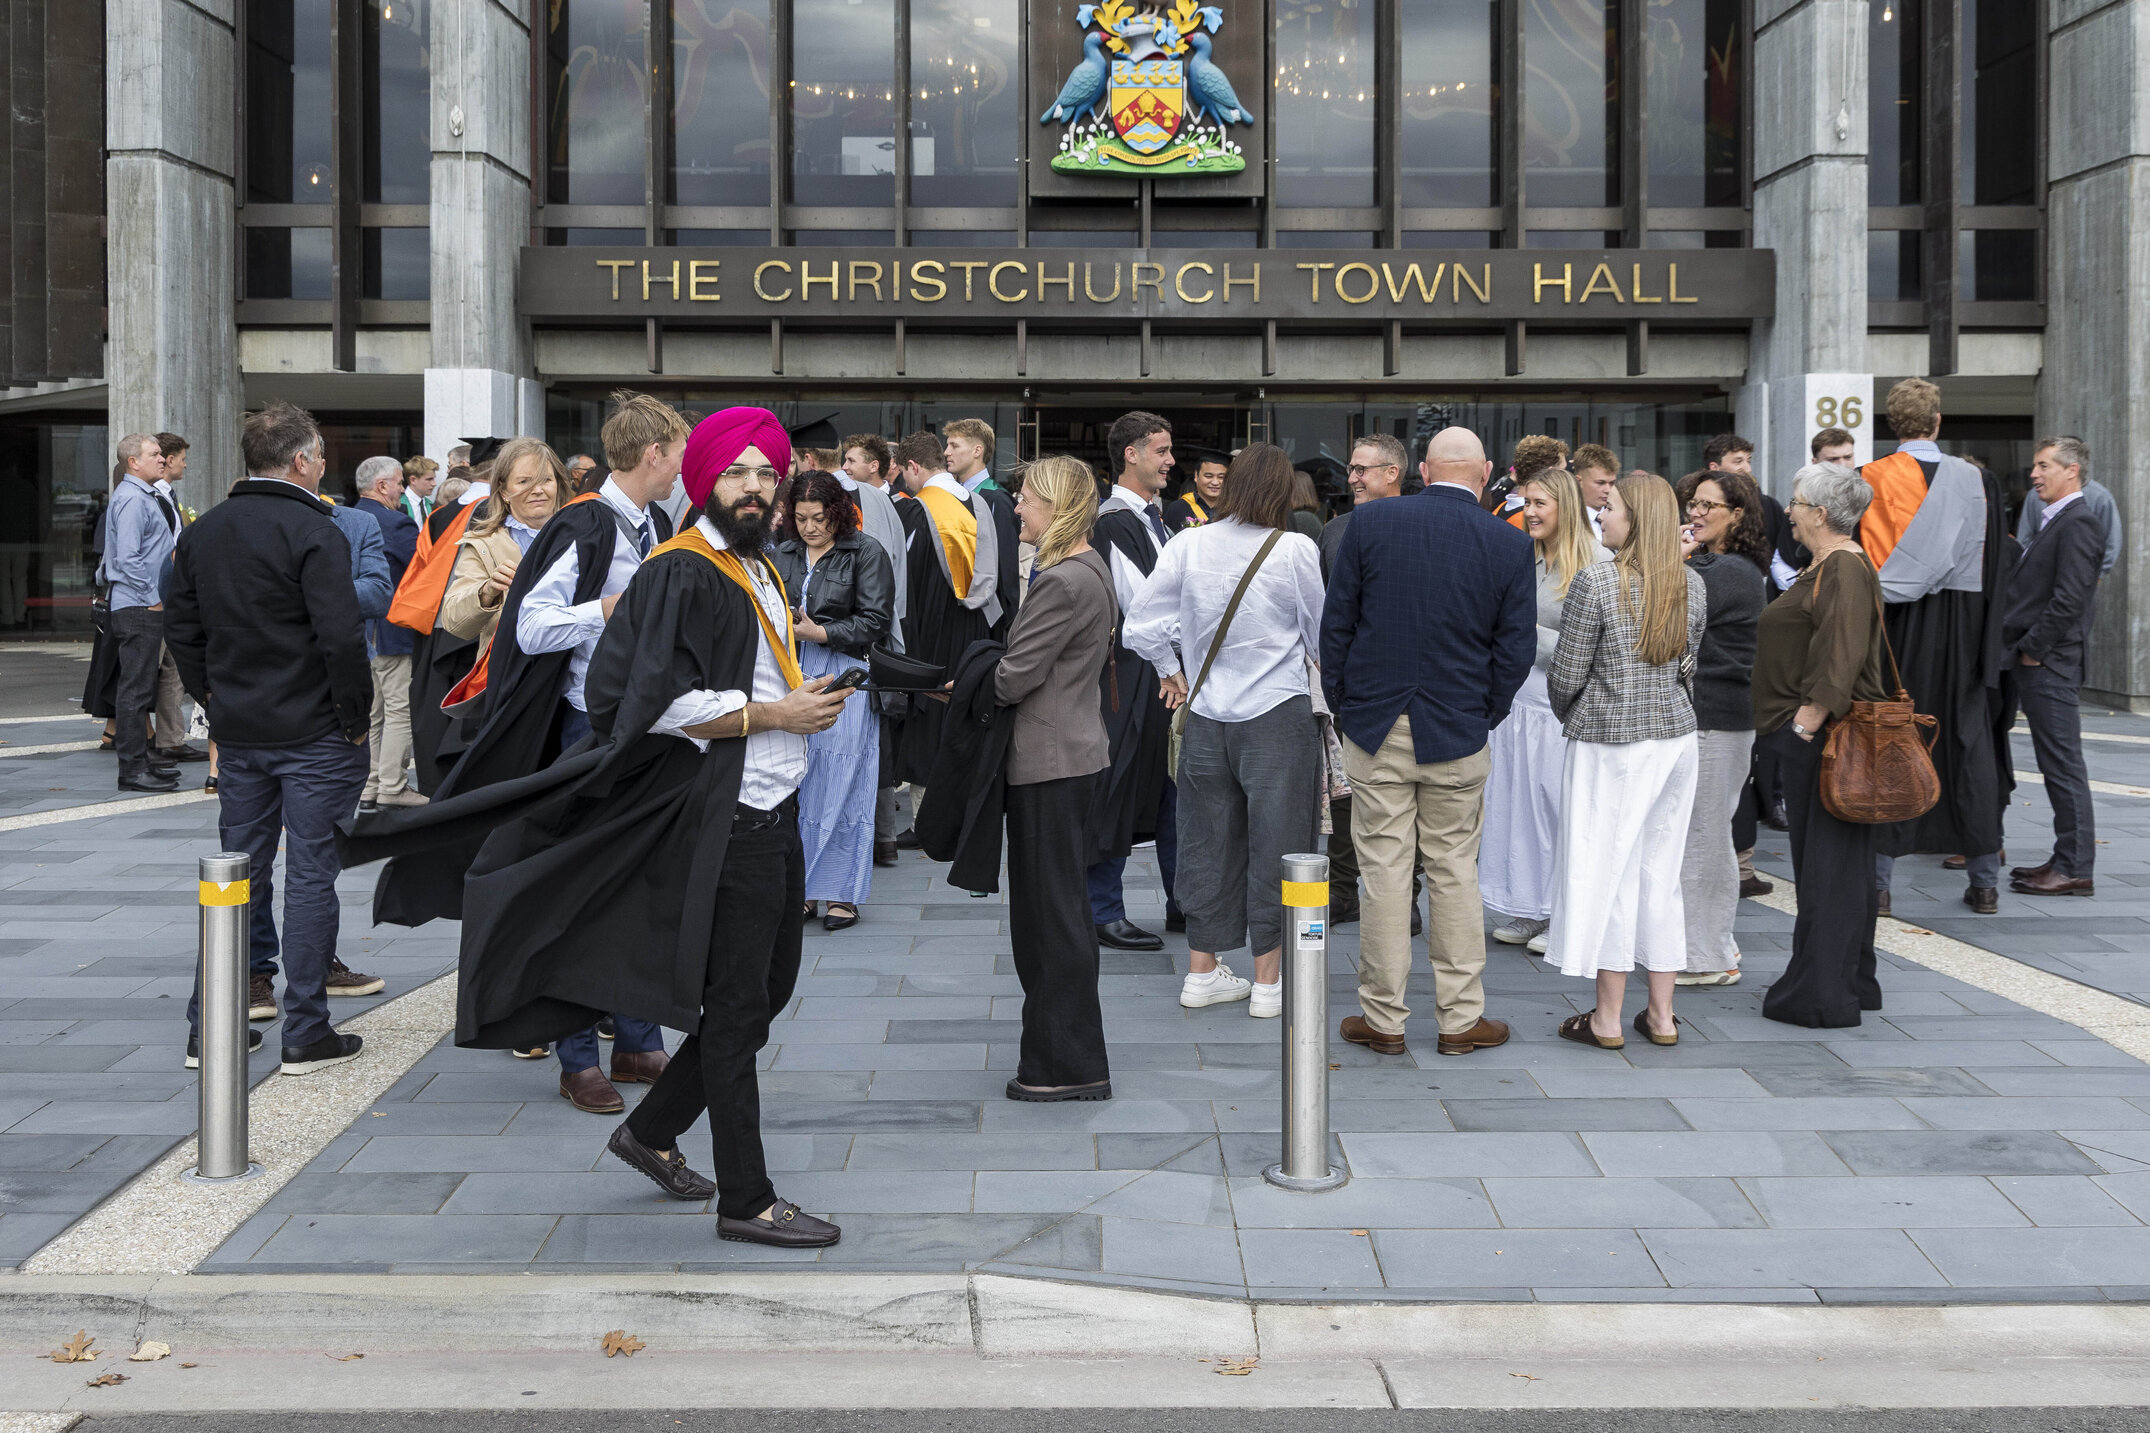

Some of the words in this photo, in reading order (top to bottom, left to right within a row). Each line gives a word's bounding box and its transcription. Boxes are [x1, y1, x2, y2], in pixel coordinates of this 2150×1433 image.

[596, 260, 721, 301] THE
[753, 260, 1262, 303] CHRISTCHURCH
[1296, 262, 1492, 305] TOWN
[1534, 262, 1699, 305] HALL
[1816, 396, 1863, 429] 86
